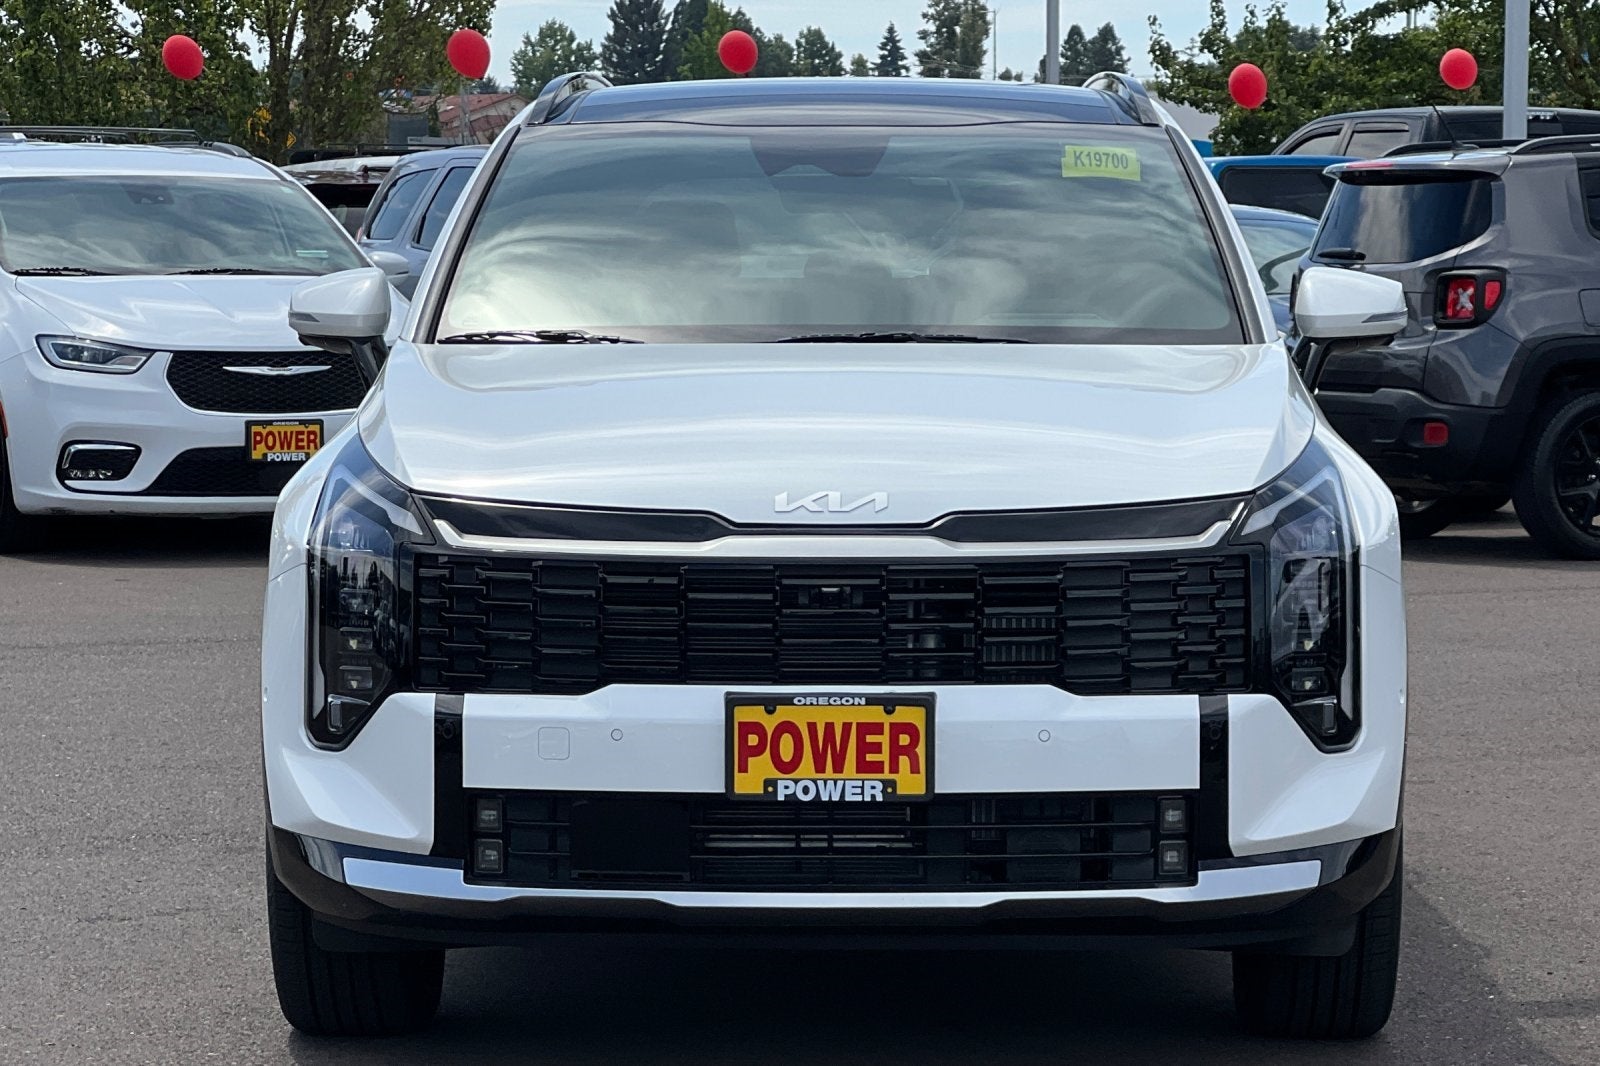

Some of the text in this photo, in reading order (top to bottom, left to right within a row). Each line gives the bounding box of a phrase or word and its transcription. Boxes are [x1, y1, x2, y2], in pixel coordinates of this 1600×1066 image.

[1073, 151, 1129, 169] K19700
[252, 430, 318, 451] POWER
[267, 452, 306, 461] POWER
[774, 491, 888, 513] KIA
[793, 697, 866, 705] OREGON
[737, 720, 921, 775] POWER
[777, 779, 883, 801] POWER
